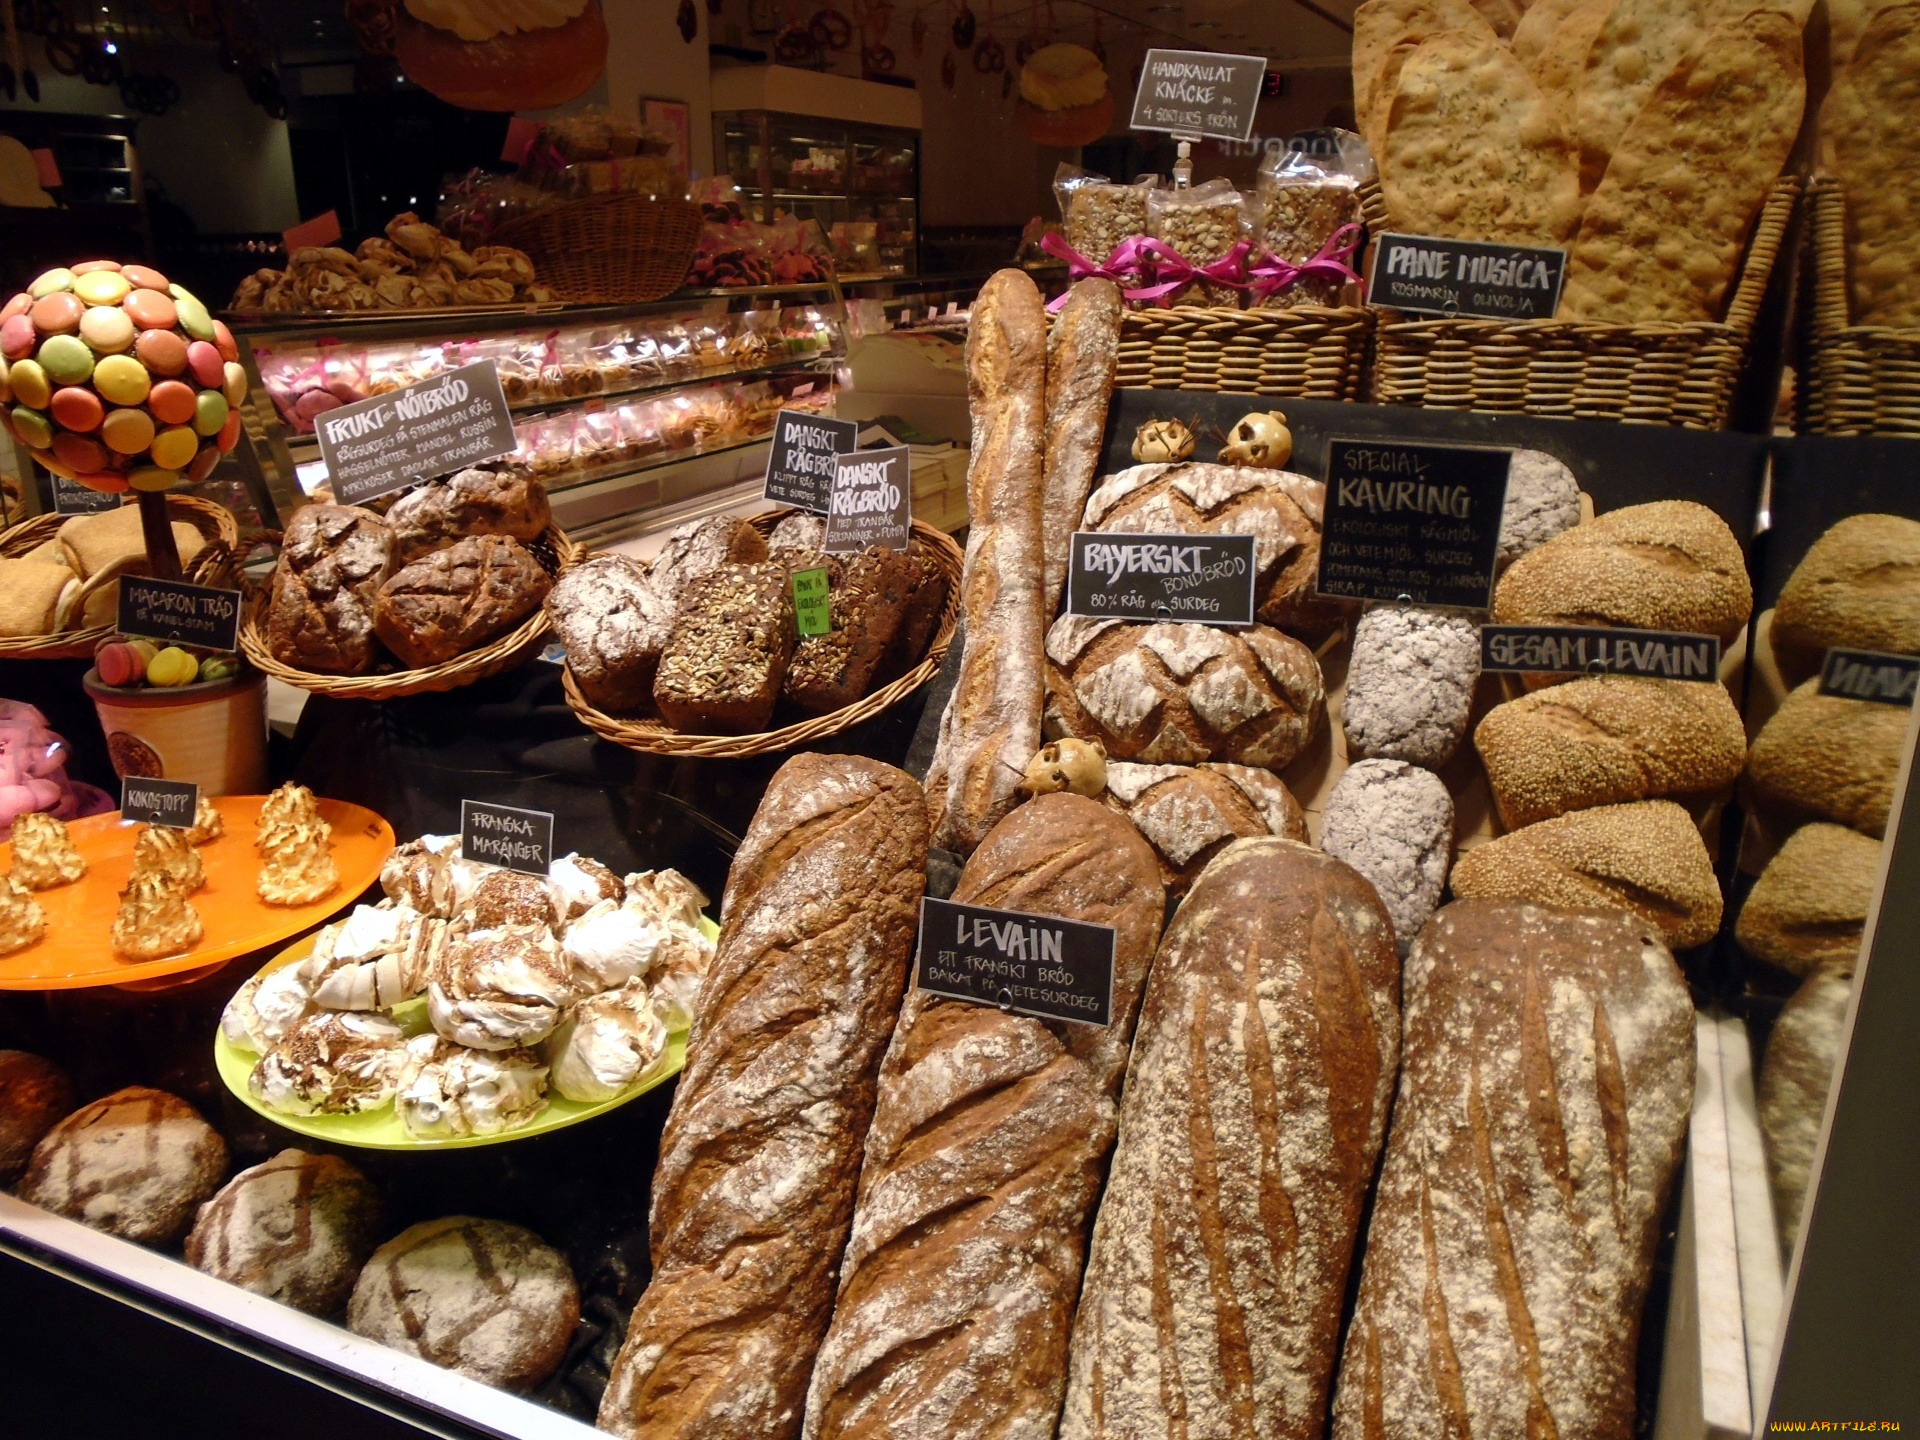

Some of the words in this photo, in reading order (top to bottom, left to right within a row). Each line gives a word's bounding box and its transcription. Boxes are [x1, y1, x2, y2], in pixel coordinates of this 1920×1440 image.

[1152, 62, 1236, 82] HANDKAVLAT
[1155, 79, 1216, 103] KNÄCKE
[1143, 105, 1152, 119] 4
[1387, 245, 1451, 280] PANE
[1457, 252, 1556, 290] MUSICA
[1391, 281, 1460, 301] ROSMARIN
[1473, 289, 1535, 316] OLIVOLJA
[325, 403, 387, 445] FRUKT
[393, 376, 469, 421] NÖTBRÖD
[336, 434, 396, 464] RÅGSURDEG
[395, 425, 408, 444] PÅ
[409, 411, 469, 439] STENMALEN
[468, 397, 494, 417] RÅG
[784, 422, 839, 451] DANSKT
[337, 449, 411, 480] HASSELNÖTTER
[415, 434, 457, 455] MANDEL
[459, 416, 498, 439] RUSSIN
[785, 446, 840, 477] RÅGBRÖ
[1344, 449, 1431, 475] SPECIAL
[341, 470, 397, 497] APRIKOSER
[441, 436, 494, 464] TRANBÄR
[837, 457, 898, 489] DANSKT
[769, 484, 786, 497] VETE
[799, 476, 816, 489] RÅG
[1338, 474, 1474, 520] KAVRING
[832, 482, 900, 516] RÅGBRÖD
[836, 517, 852, 530] MED
[857, 511, 895, 528] TRANBÄR
[1084, 543, 1212, 589] BAYERSKT
[1160, 551, 1246, 594] BONDBRÖD
[1424, 550, 1474, 566] SURDEG
[129, 586, 197, 615] MACARON
[199, 594, 234, 620] TRÄD
[1121, 590, 1146, 609] RÅG
[1170, 596, 1220, 612] SURDEG
[1489, 634, 1588, 669] SESAM
[1598, 637, 1709, 677] LEVAIN
[128, 790, 189, 813] KOKOSTOPP
[471, 812, 536, 837] FRANSKA
[472, 835, 544, 864] MARÄNGER
[957, 914, 1063, 963] LEVAIN
[929, 966, 973, 987] BAKAT
[982, 973, 997, 991] PÅ
[938, 950, 957, 968] ETT
[965, 955, 1026, 980] FRANSKT
[1038, 965, 1074, 986] BRÖD
